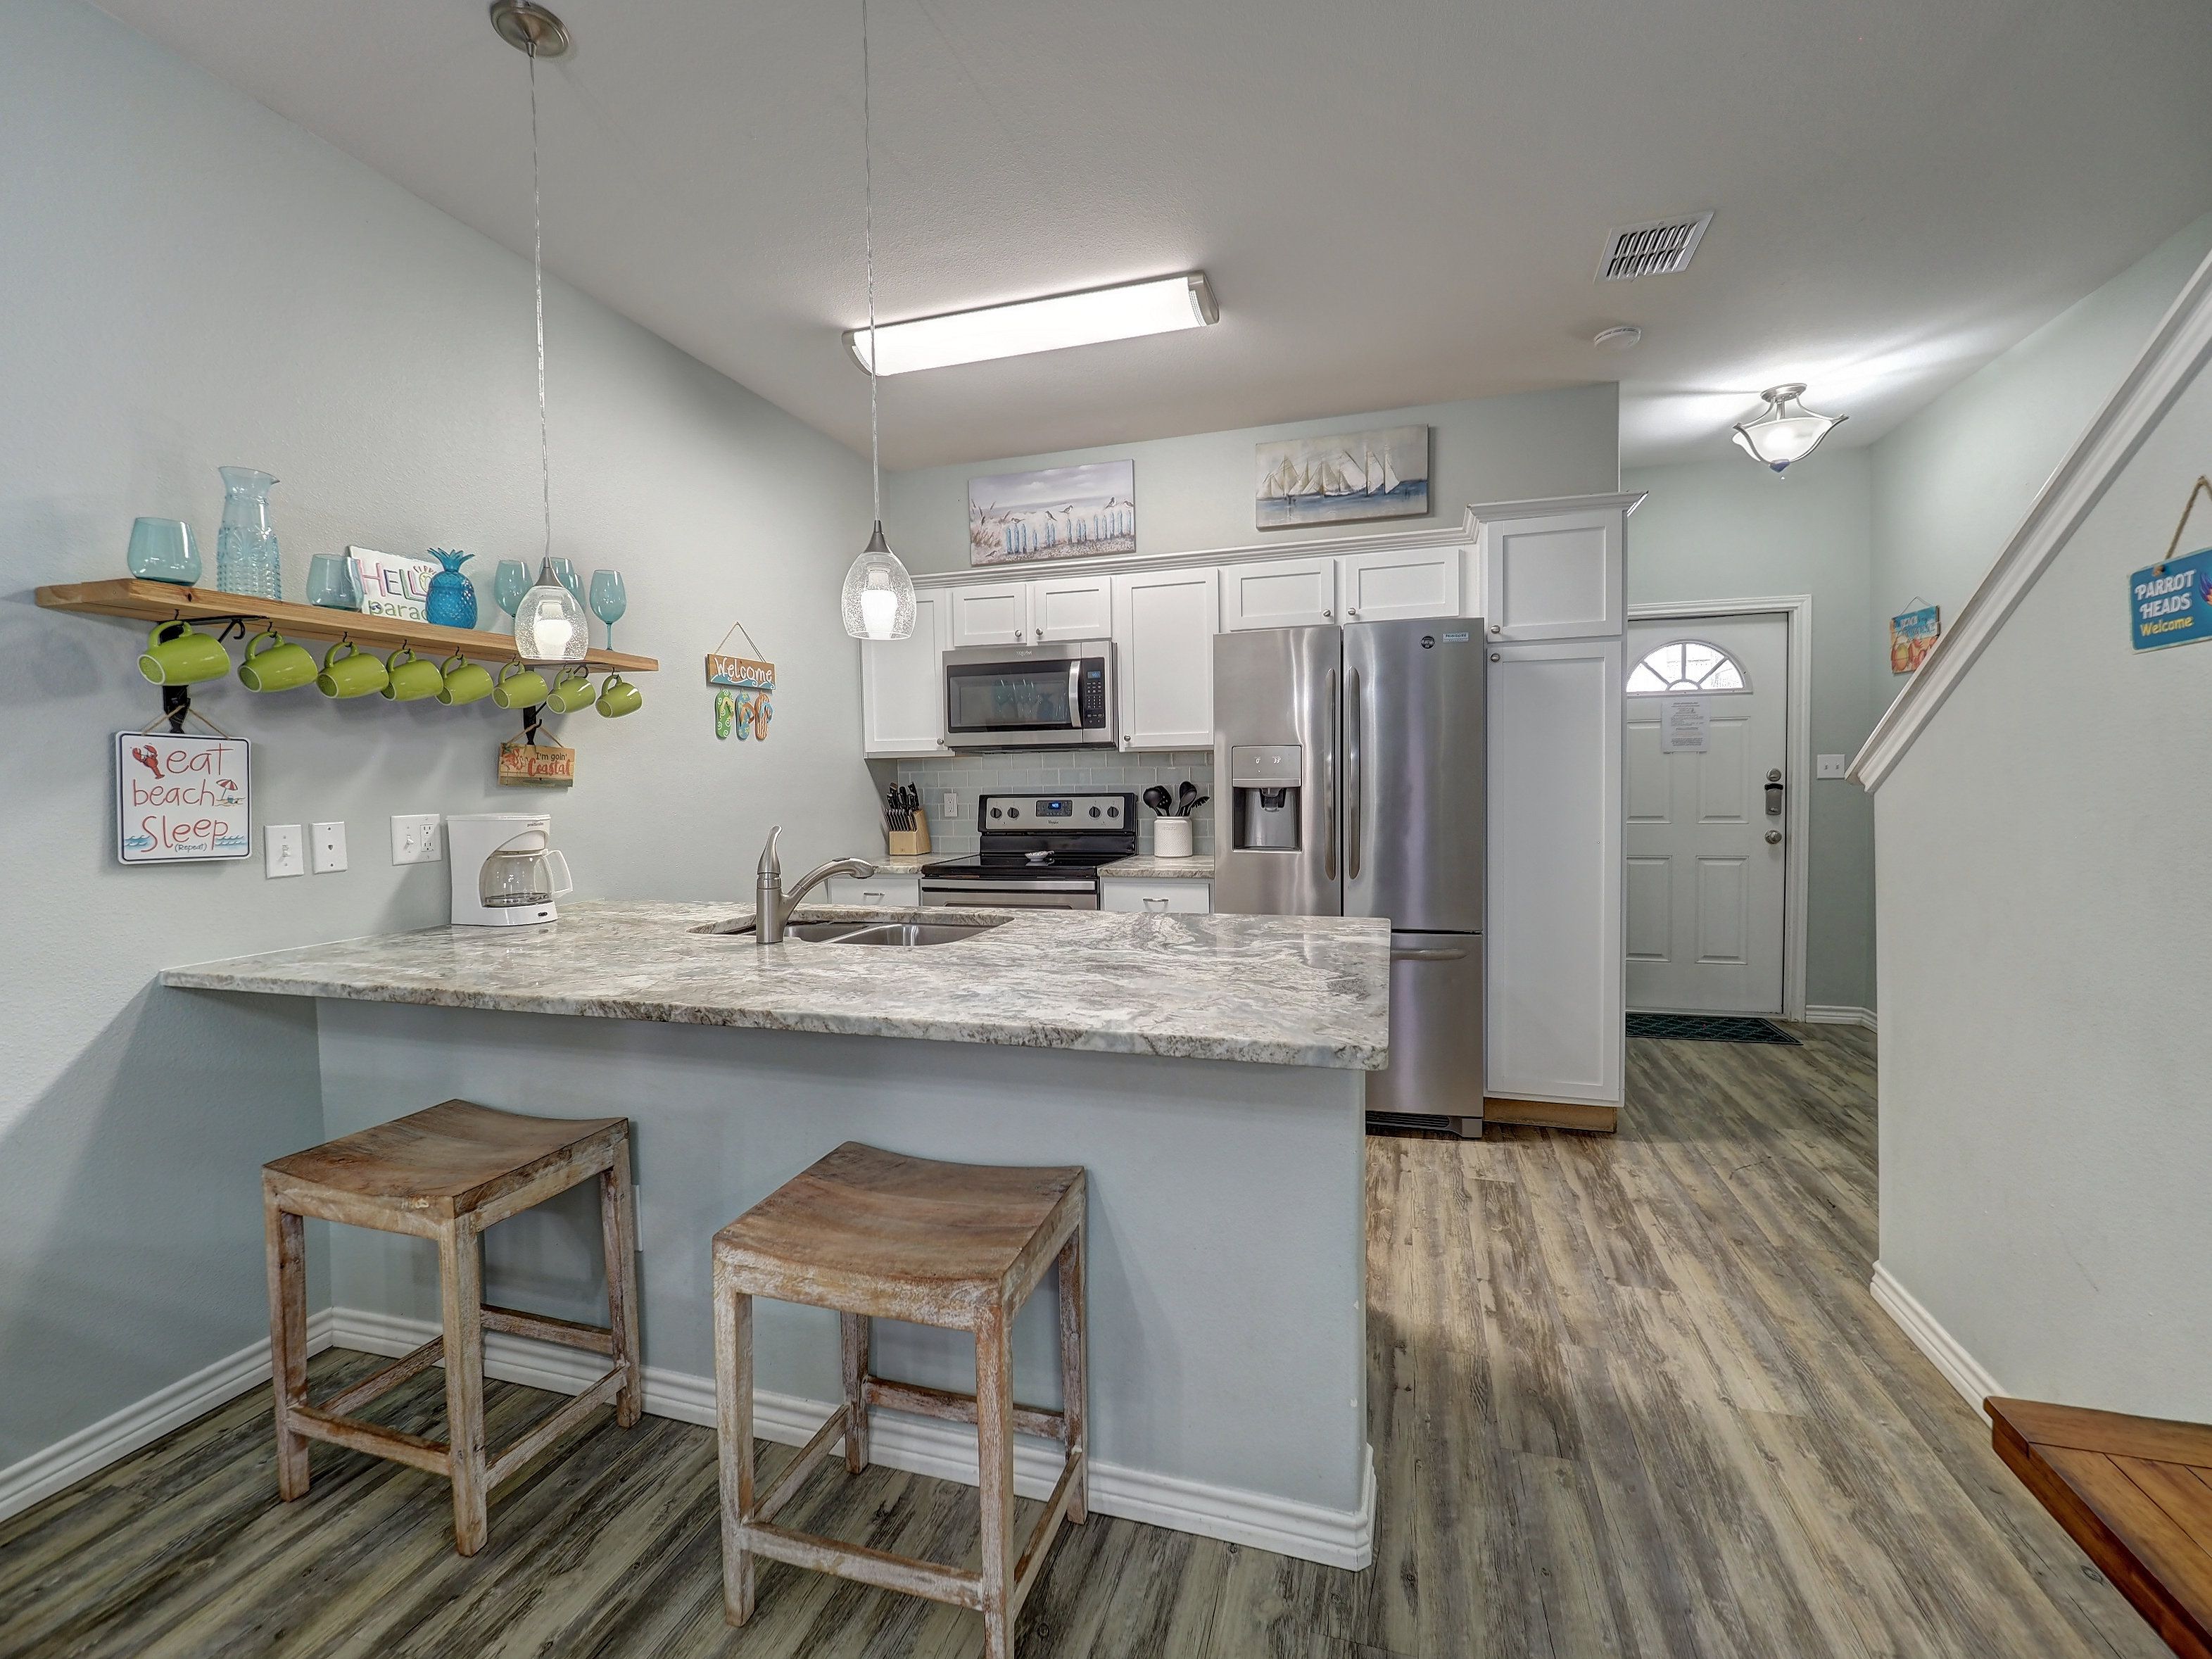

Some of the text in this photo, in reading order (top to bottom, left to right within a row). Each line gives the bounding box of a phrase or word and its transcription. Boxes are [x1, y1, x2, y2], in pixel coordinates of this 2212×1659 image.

[2134, 569, 2197, 601] PARROT
[2138, 592, 2193, 620] HEADS
[2140, 616, 2194, 637] Welcome
[713, 657, 773, 682] Welcome
[166, 743, 234, 776] eat
[528, 757, 571, 777] Coastal
[536, 752, 567, 762] I'm goin'
[132, 778, 215, 807] beach
[140, 815, 229, 852] Sleep
[175, 843, 208, 853] (Repeat)
